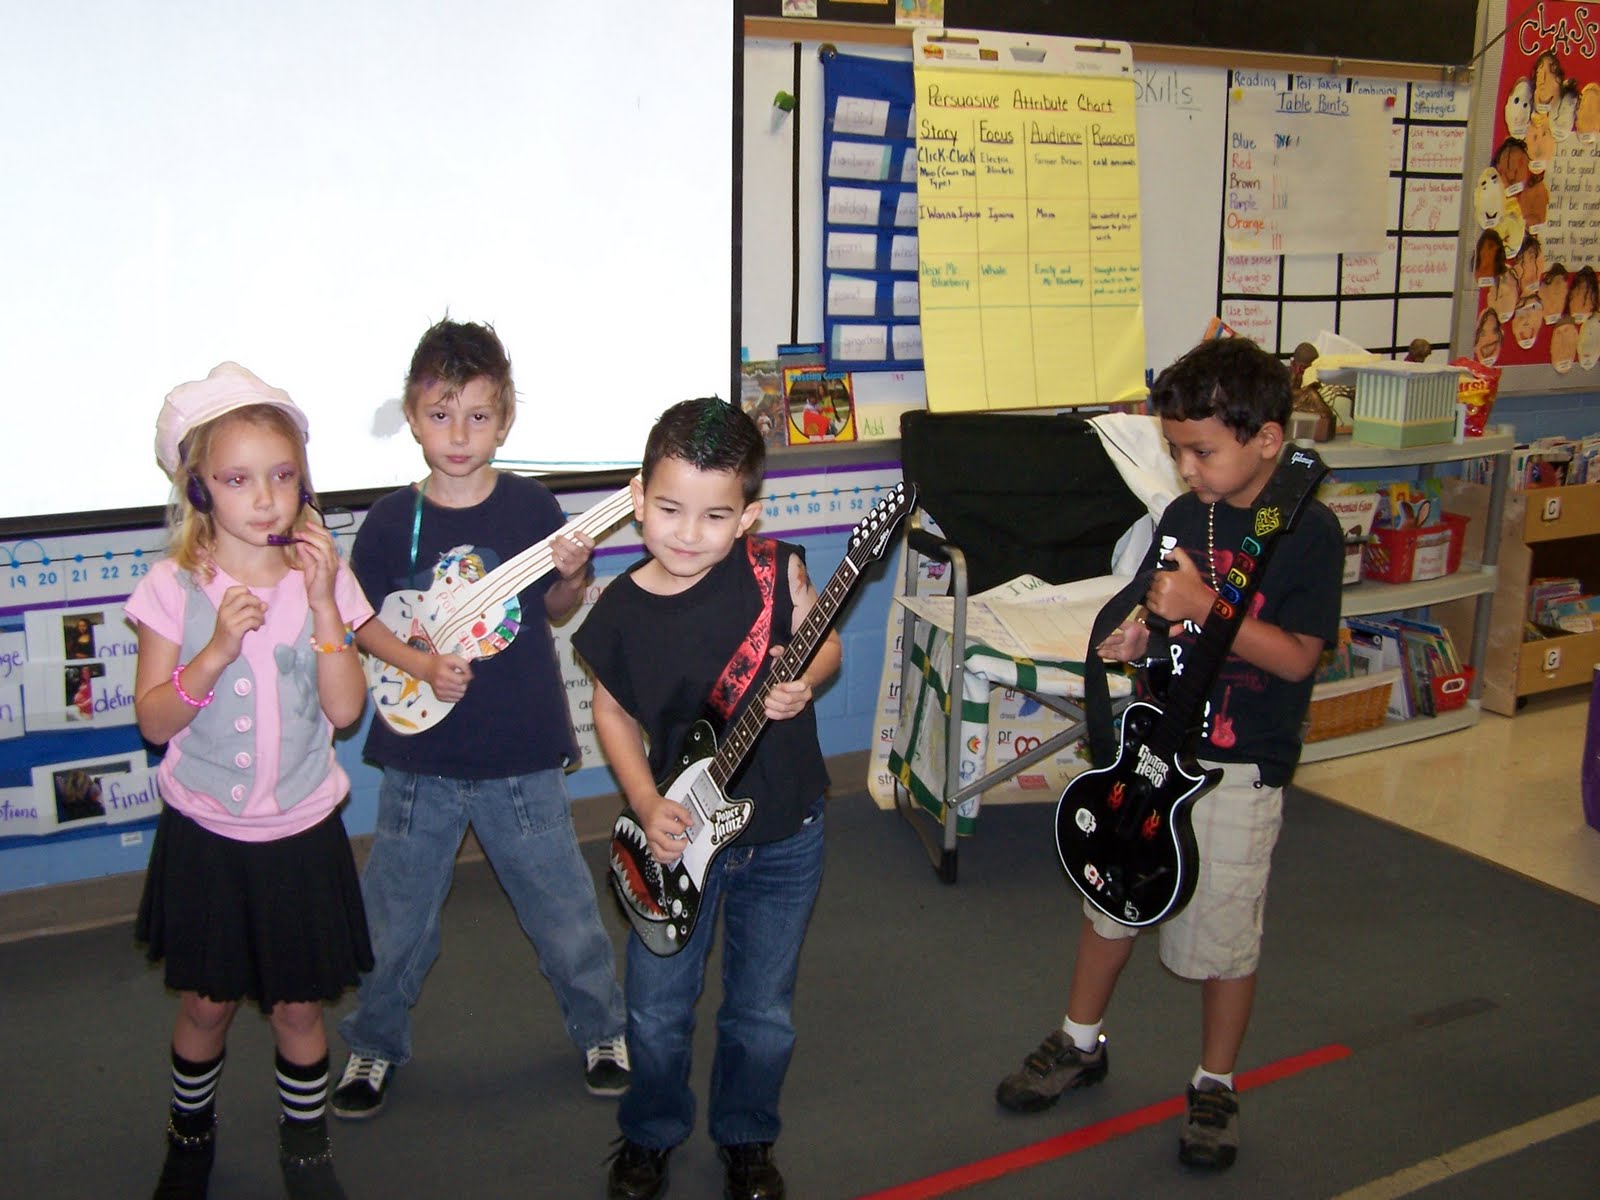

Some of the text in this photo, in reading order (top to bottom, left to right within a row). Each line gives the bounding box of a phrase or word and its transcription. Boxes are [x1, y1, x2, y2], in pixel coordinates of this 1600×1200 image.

[1519, 2, 1599, 59] CLASS
[1234, 71, 1276, 90] Reading
[1353, 81, 1397, 95] Combining
[928, 85, 1112, 112] Persuasive Attribute Chart
[1276, 92, 1349, 116] Table Points
[1413, 102, 1456, 117] Strategies
[920, 119, 958, 145] Story
[980, 120, 1014, 144] Focus
[1031, 122, 1082, 144] Audience
[1092, 124, 1135, 147] Reasons
[1232, 132, 1256, 149] Blue
[1232, 152, 1251, 169] Red
[1230, 172, 1260, 189] Brown
[1230, 193, 1258, 212] Purple
[1227, 213, 1264, 235] Orange
[863, 417, 885, 436] Add
[765, 508, 779, 517] 48
[786, 505, 800, 515] 49
[807, 503, 821, 513] 50
[829, 501, 841, 512] 51
[850, 499, 863, 509] 52
[1548, 499, 1556, 515] C
[10, 563, 149, 588] 19 20 21 22 23
[0, 651, 23, 678] ge
[998, 731, 1012, 746] pr
[711, 816, 744, 846] Jamz
